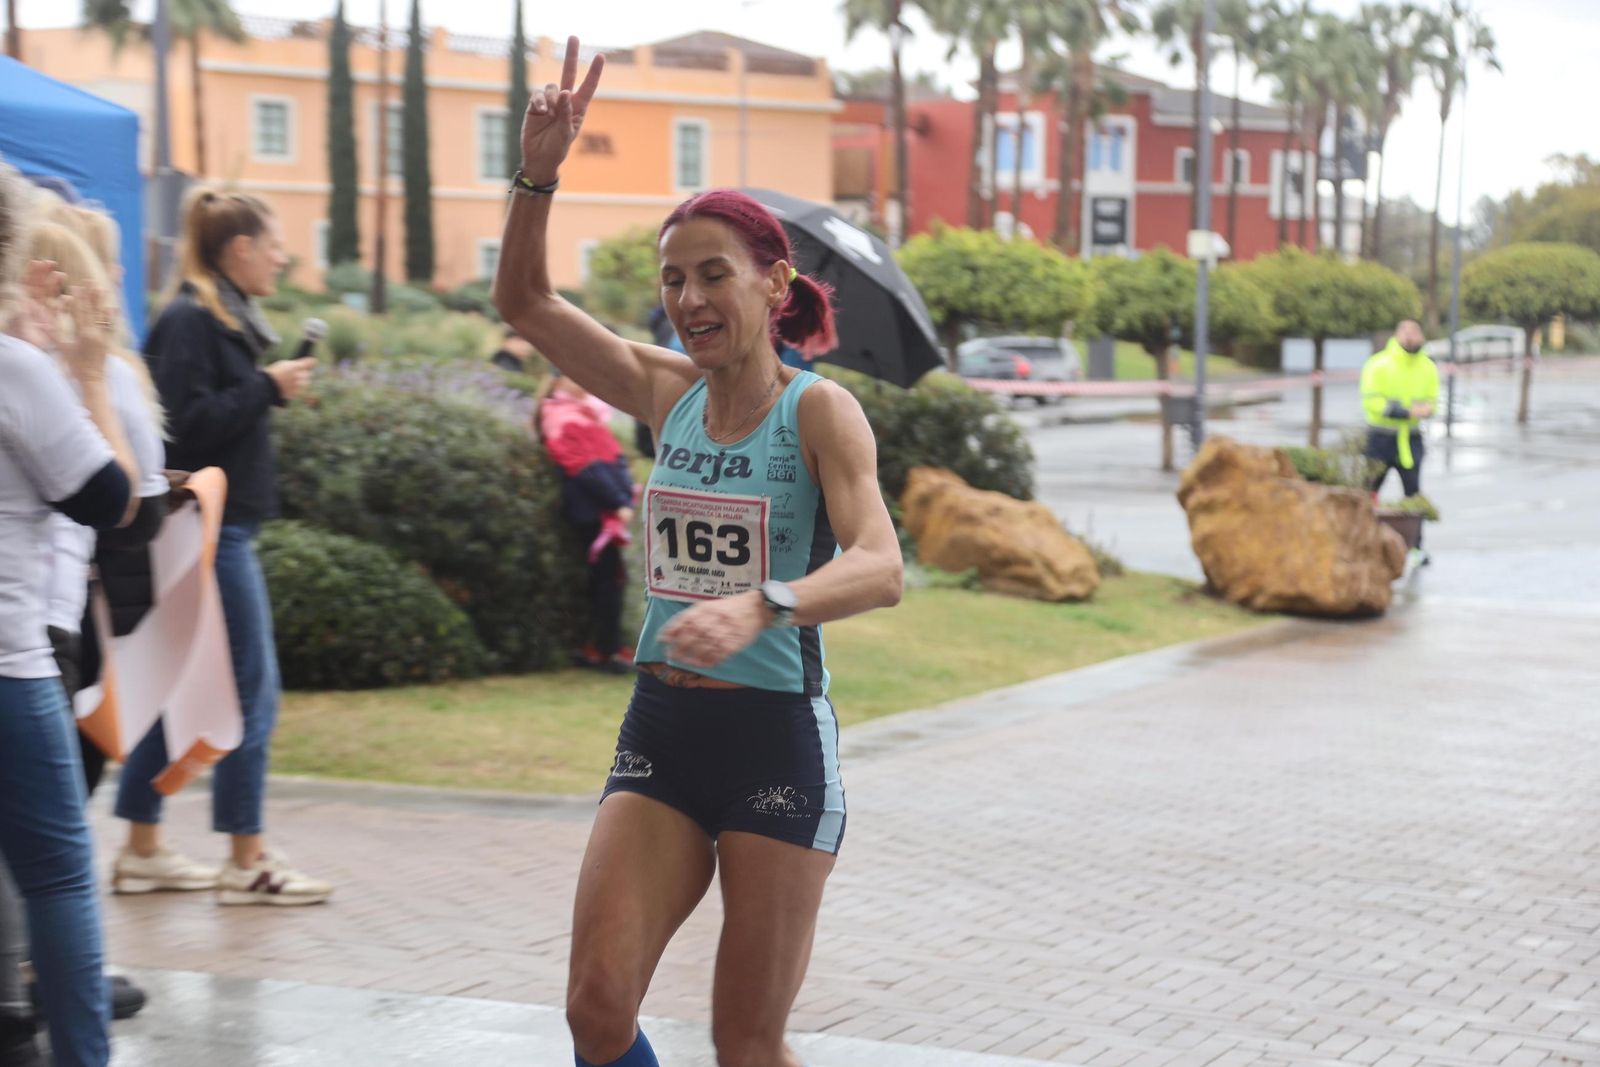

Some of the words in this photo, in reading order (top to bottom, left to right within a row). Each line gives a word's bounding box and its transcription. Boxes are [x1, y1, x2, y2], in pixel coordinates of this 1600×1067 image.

[769, 455, 790, 464] nerja
[767, 469, 796, 481] aen
[656, 517, 751, 567] 163
